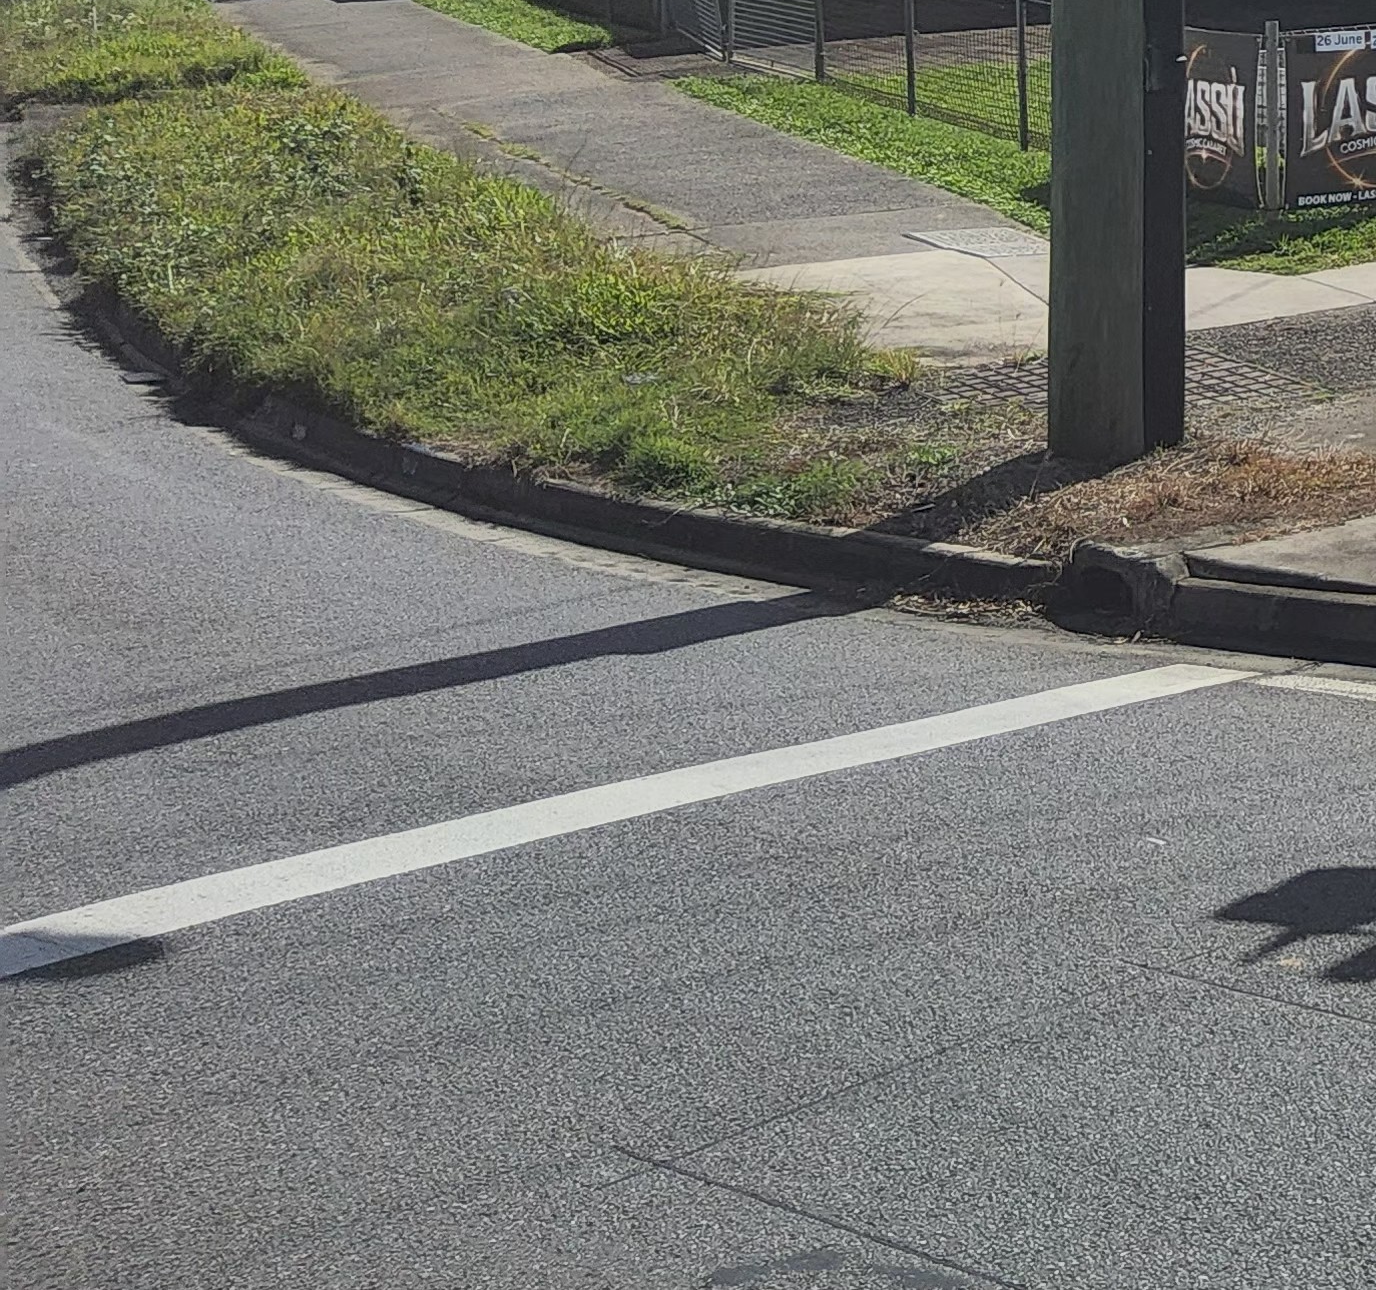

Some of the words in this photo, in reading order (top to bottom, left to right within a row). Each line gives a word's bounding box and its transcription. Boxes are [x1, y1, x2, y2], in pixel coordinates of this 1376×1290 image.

[1317, 35, 1332, 46] 26
[1334, 34, 1363, 46] June
[1298, 194, 1327, 206] BOOK
[1329, 192, 1352, 203] NOW
